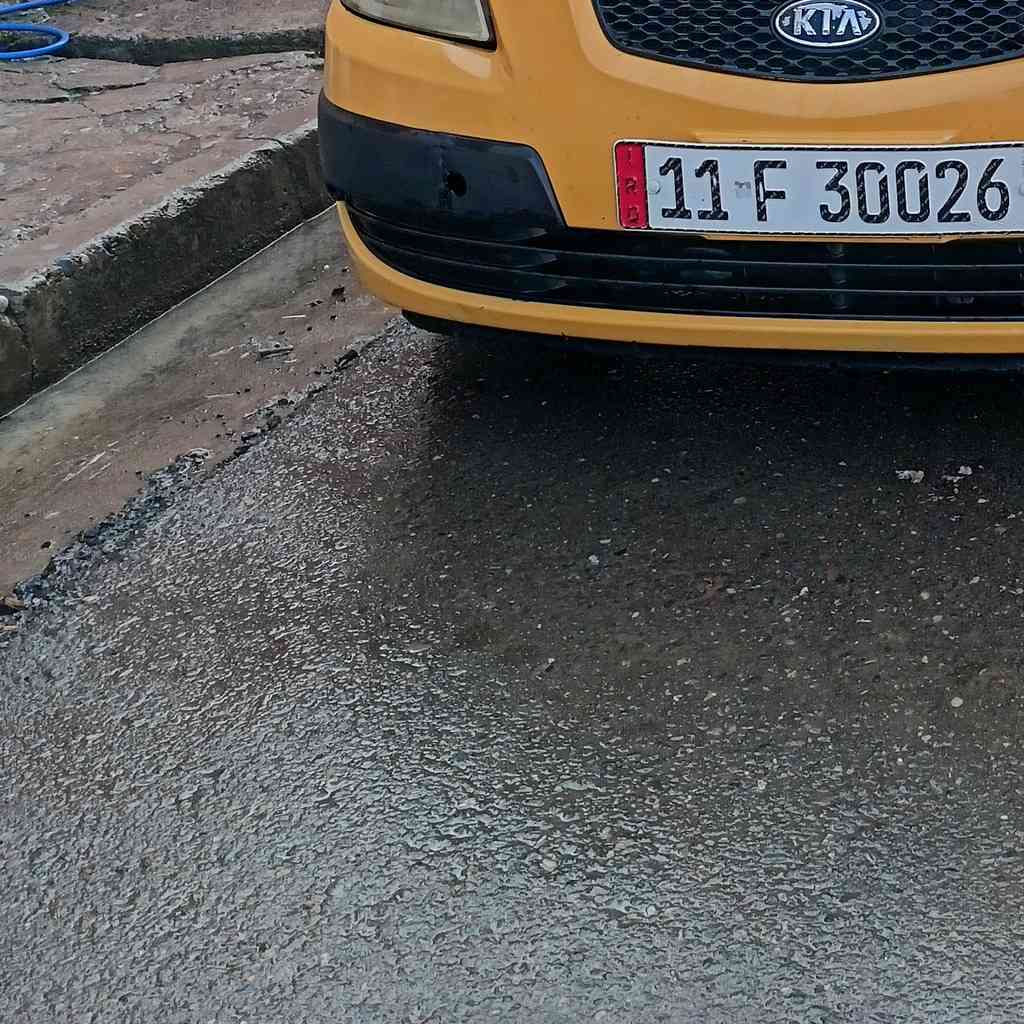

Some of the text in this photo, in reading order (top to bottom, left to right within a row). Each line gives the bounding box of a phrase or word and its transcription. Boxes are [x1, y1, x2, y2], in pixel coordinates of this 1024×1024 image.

[793, 8, 862, 36] KIA
[659, 157, 1010, 223] 11 F 30026
